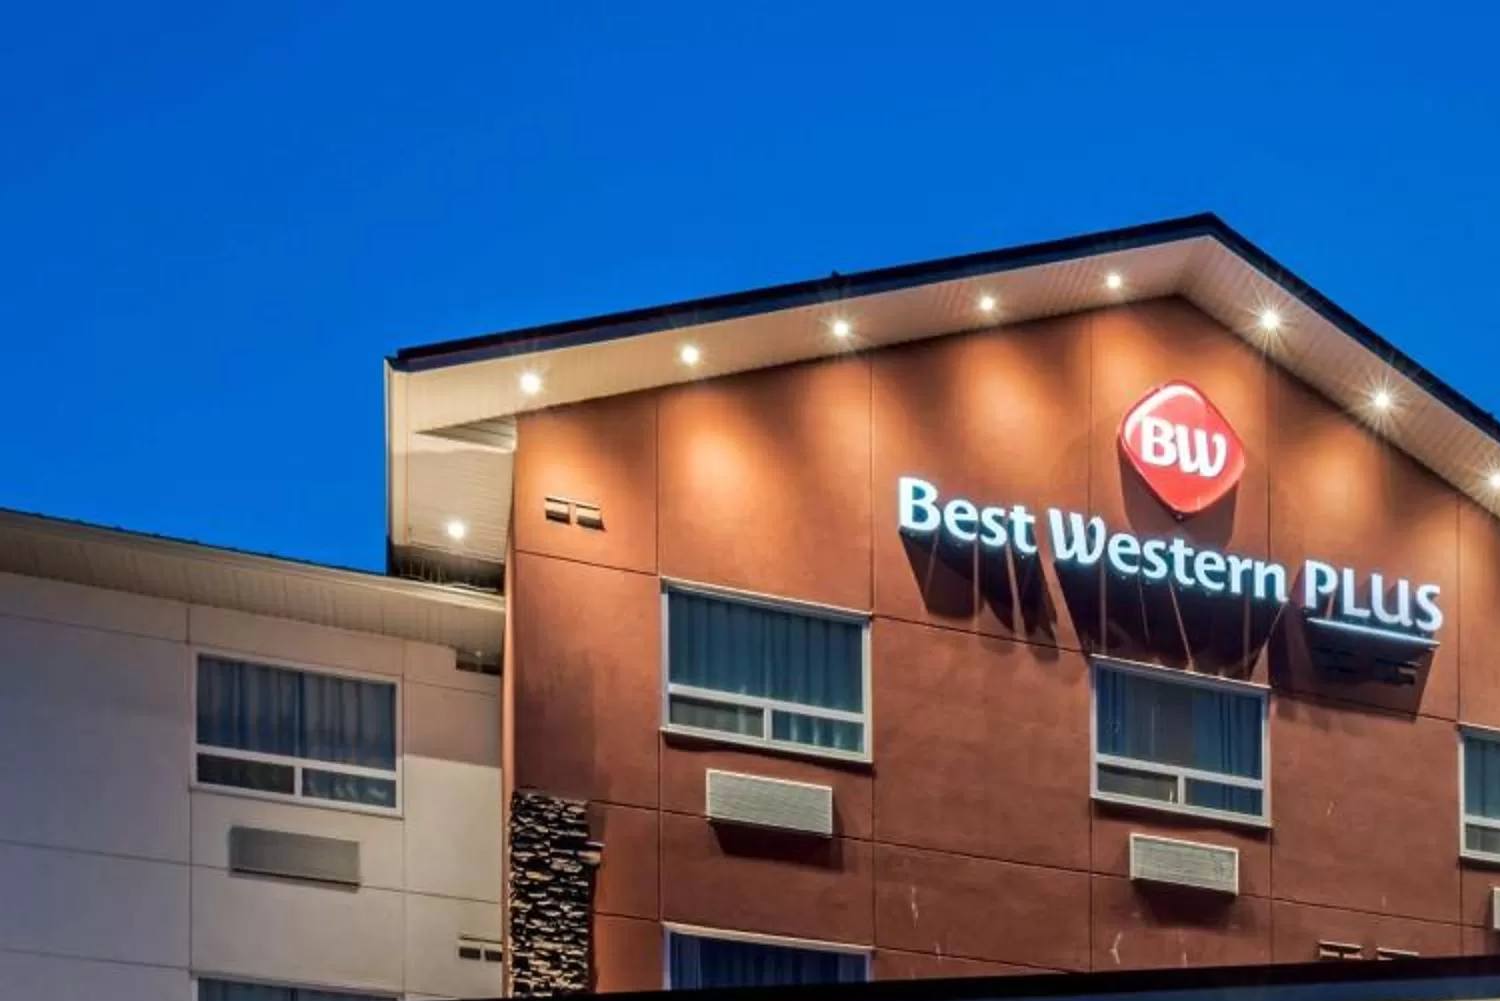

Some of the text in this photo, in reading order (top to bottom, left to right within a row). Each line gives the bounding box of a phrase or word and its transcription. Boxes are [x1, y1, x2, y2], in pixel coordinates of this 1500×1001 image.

[1139, 415, 1228, 478] BW
[898, 476, 1444, 633] Best Western PLUS
